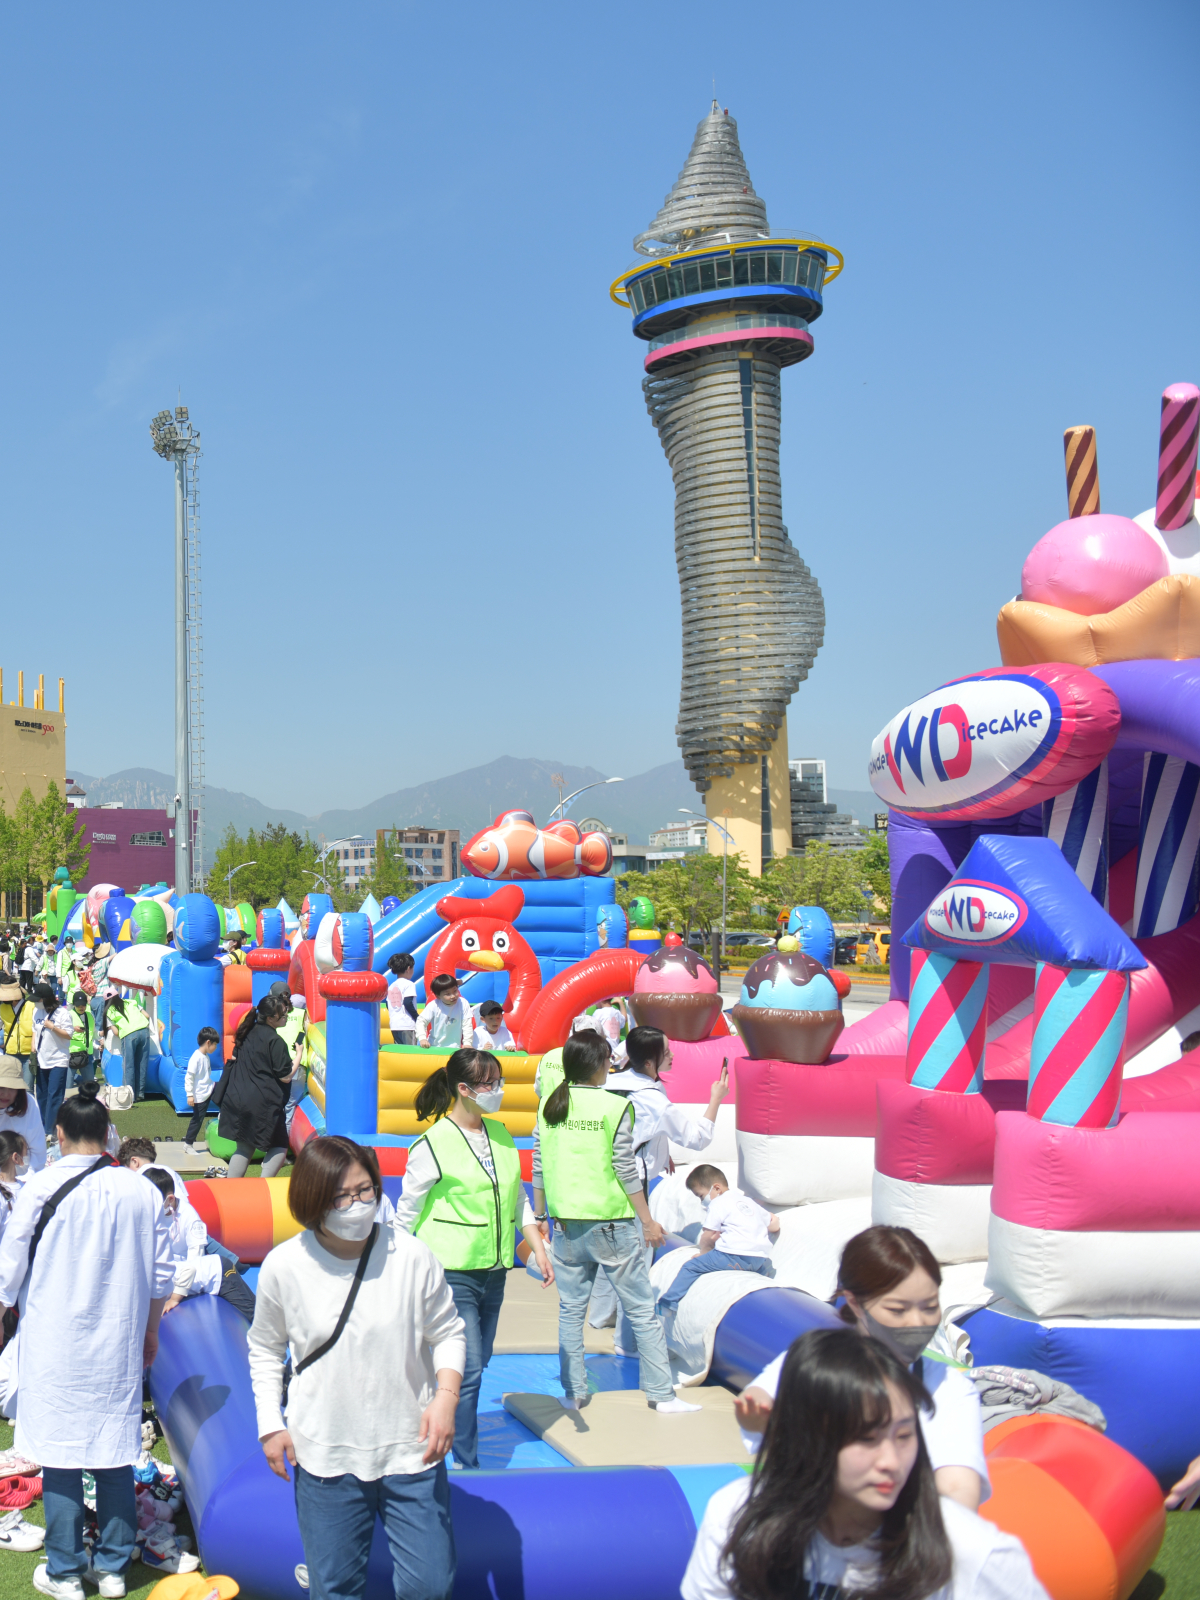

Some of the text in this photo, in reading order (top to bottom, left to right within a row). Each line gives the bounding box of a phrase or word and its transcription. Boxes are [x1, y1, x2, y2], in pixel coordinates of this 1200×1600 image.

[868, 752, 889, 775] onder
[962, 708, 1043, 742] icecake
[982, 908, 1015, 921] icecake
[545, 1119, 605, 1132] 속어린이집연합회
